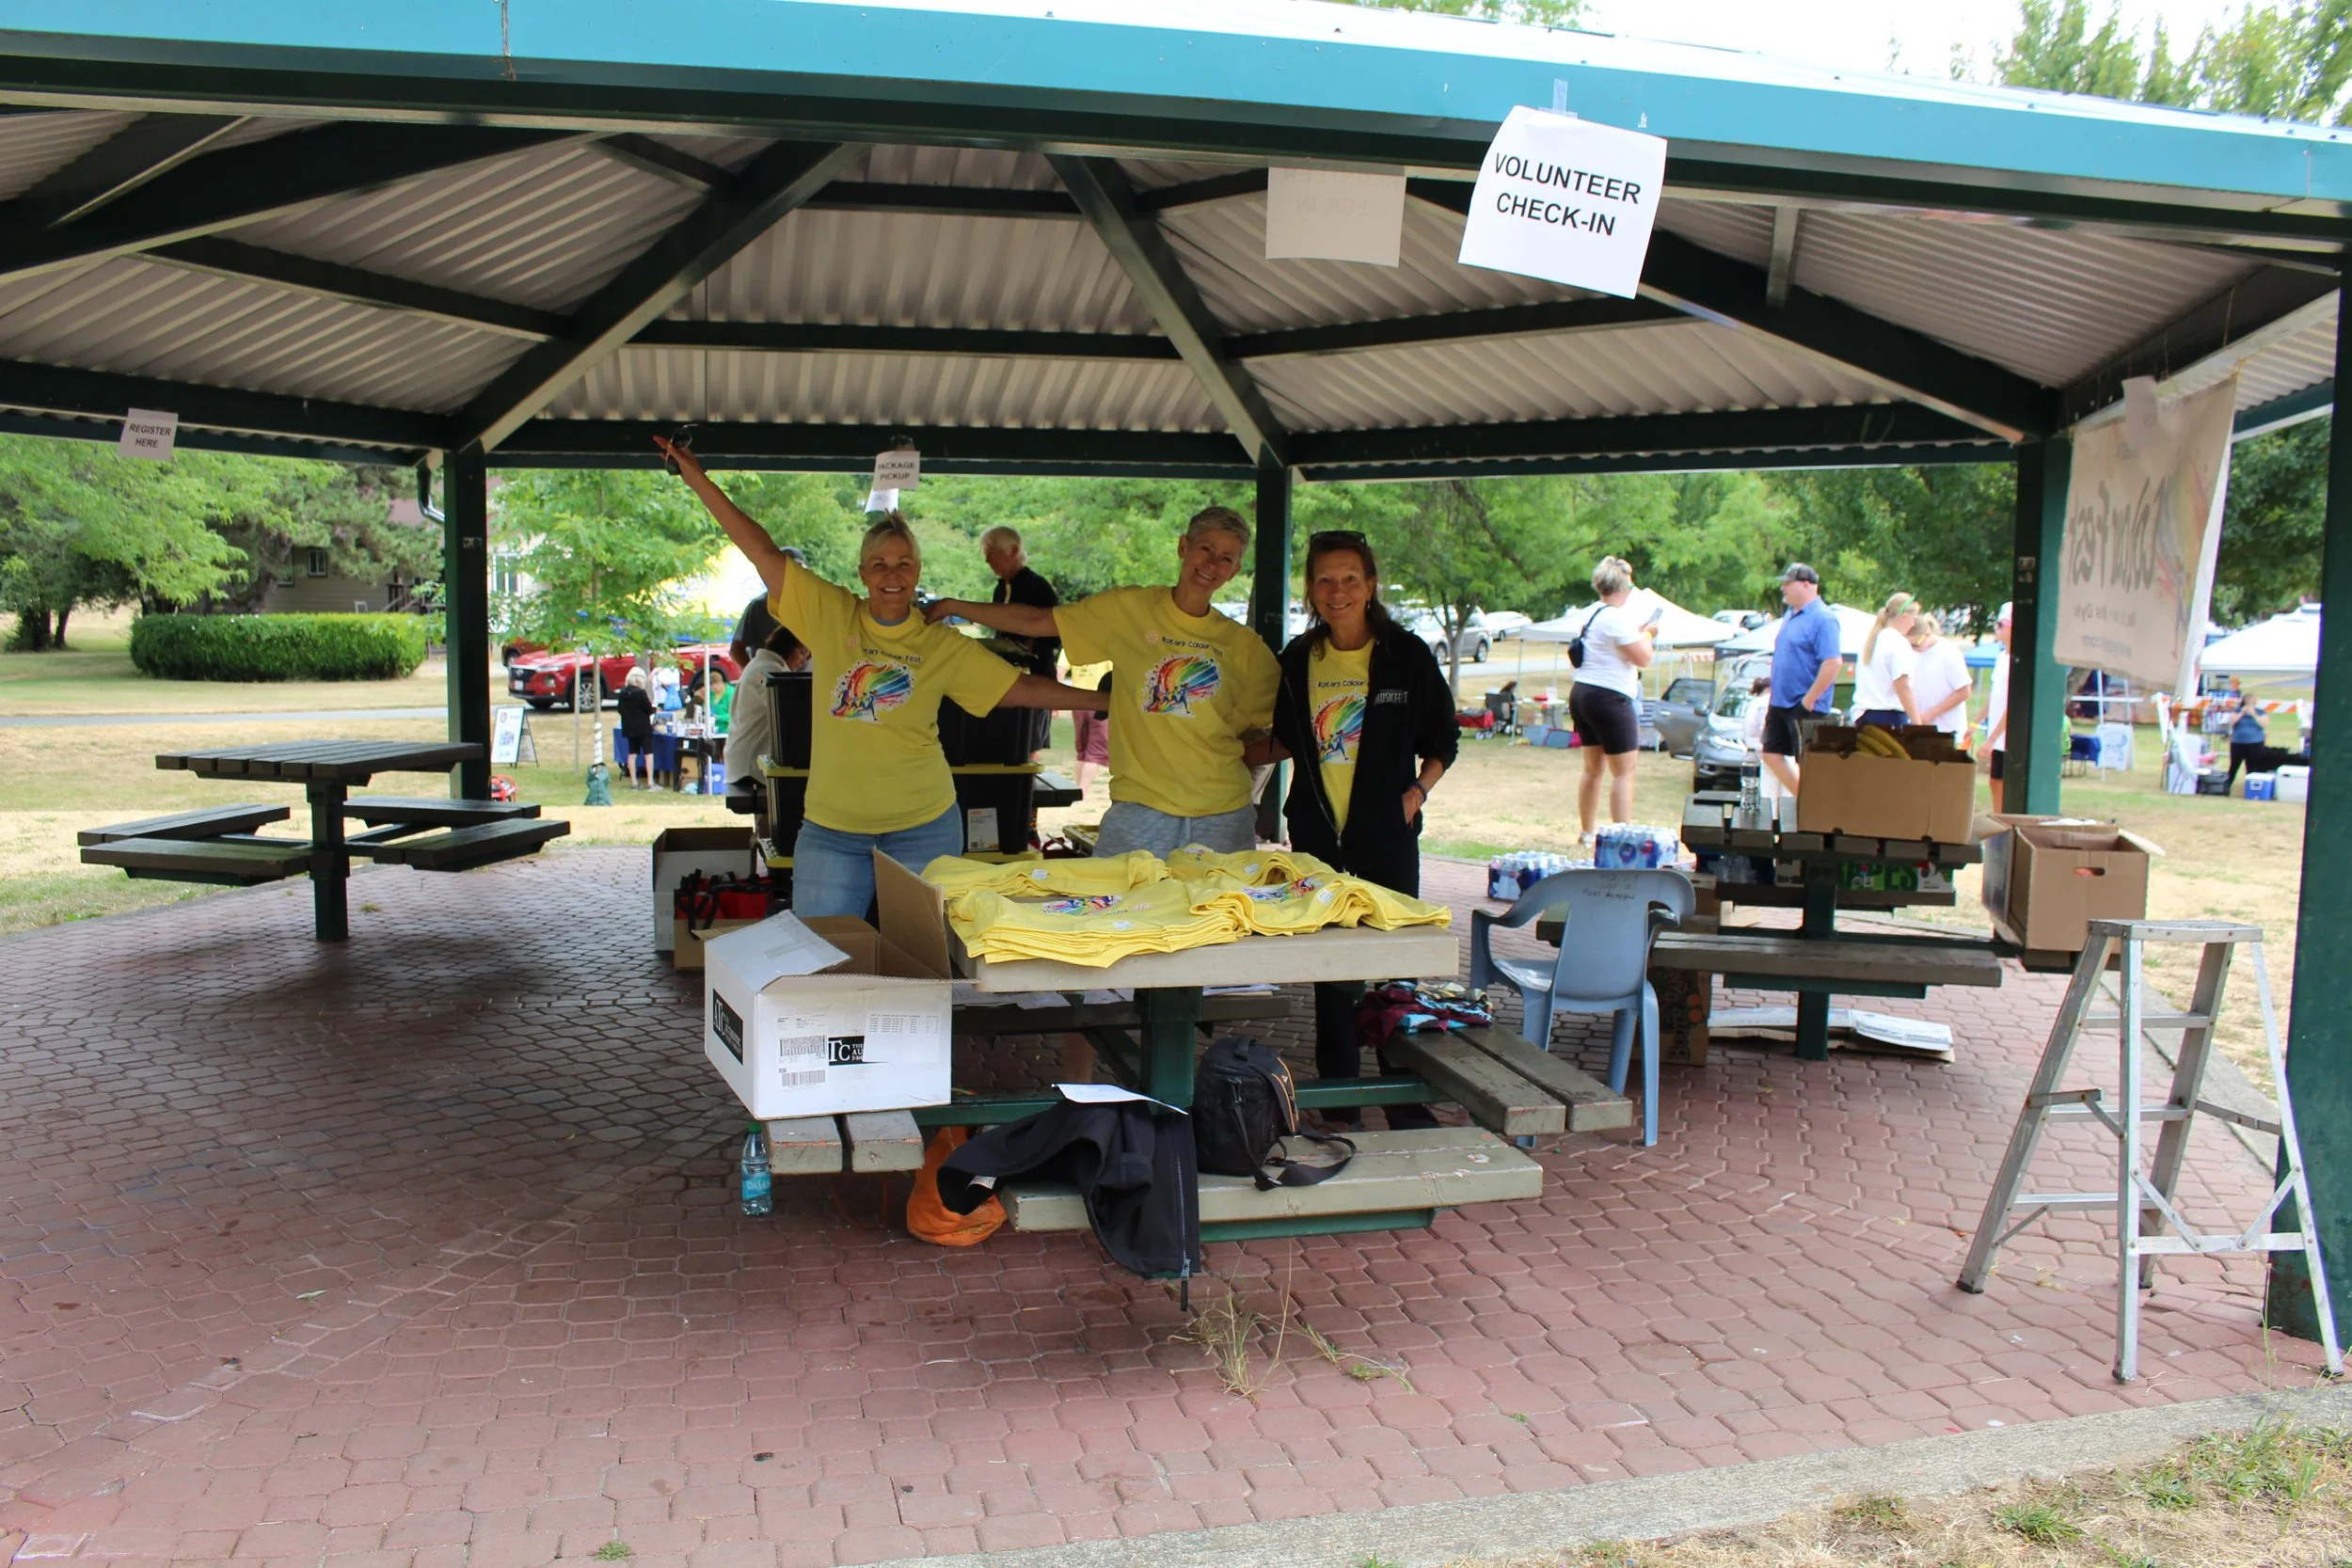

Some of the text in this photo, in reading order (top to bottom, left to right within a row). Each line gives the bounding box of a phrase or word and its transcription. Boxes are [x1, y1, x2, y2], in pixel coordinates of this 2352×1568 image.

[1495, 152, 1641, 204] VOLUNTEER
[1496, 193, 1615, 236] CHECK-IN
[129, 423, 171, 436] REGISTER
[135, 437, 158, 448] HERE
[878, 461, 915, 470] PACKAGE
